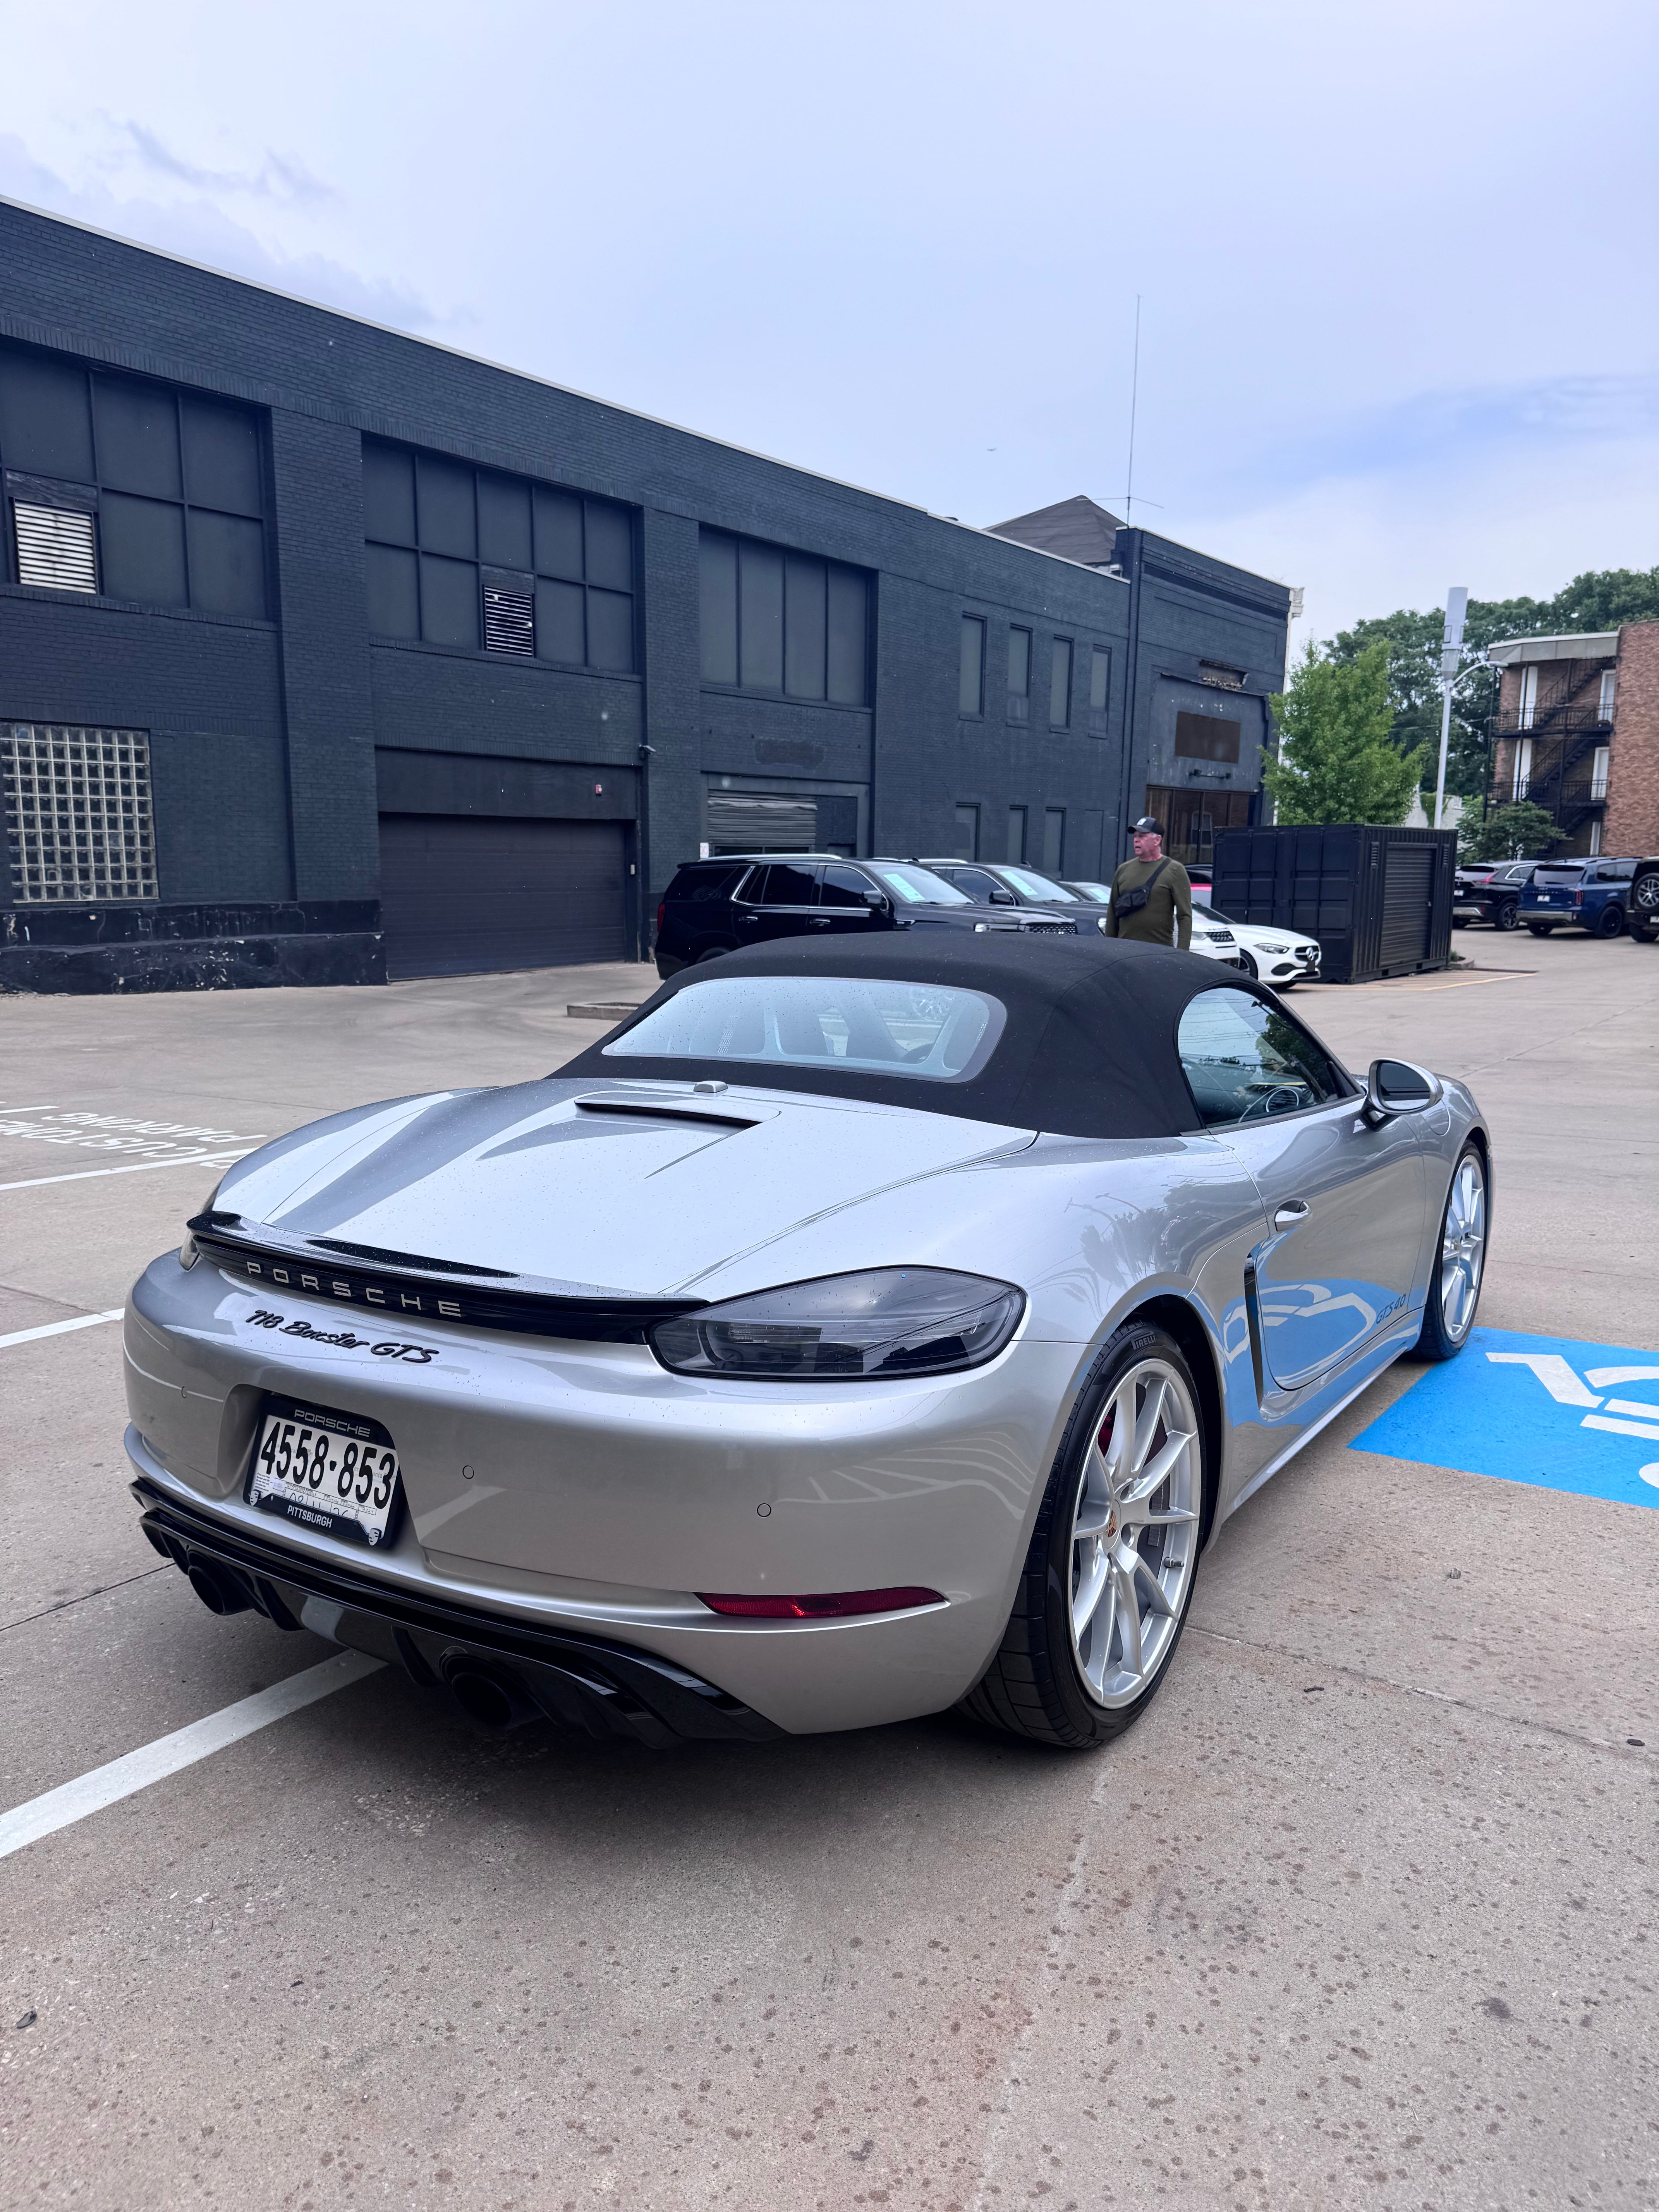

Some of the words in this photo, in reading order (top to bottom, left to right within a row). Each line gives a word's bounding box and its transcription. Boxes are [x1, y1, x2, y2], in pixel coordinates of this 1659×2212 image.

[0, 1120, 208, 1158] CUSTOME
[41, 1112, 268, 1143] PARKING
[246, 1261, 462, 1317] PORSCHE
[1376, 1301, 1395, 1324] GTS
[246, 1310, 284, 1328] 718
[279, 1321, 370, 1349] Boxster
[370, 1342, 440, 1363] GTS
[1130, 1331, 1156, 1350] PIRELLI
[294, 1409, 371, 1437] PORSCHE
[287, 1505, 333, 1528] PITTSBURGH
